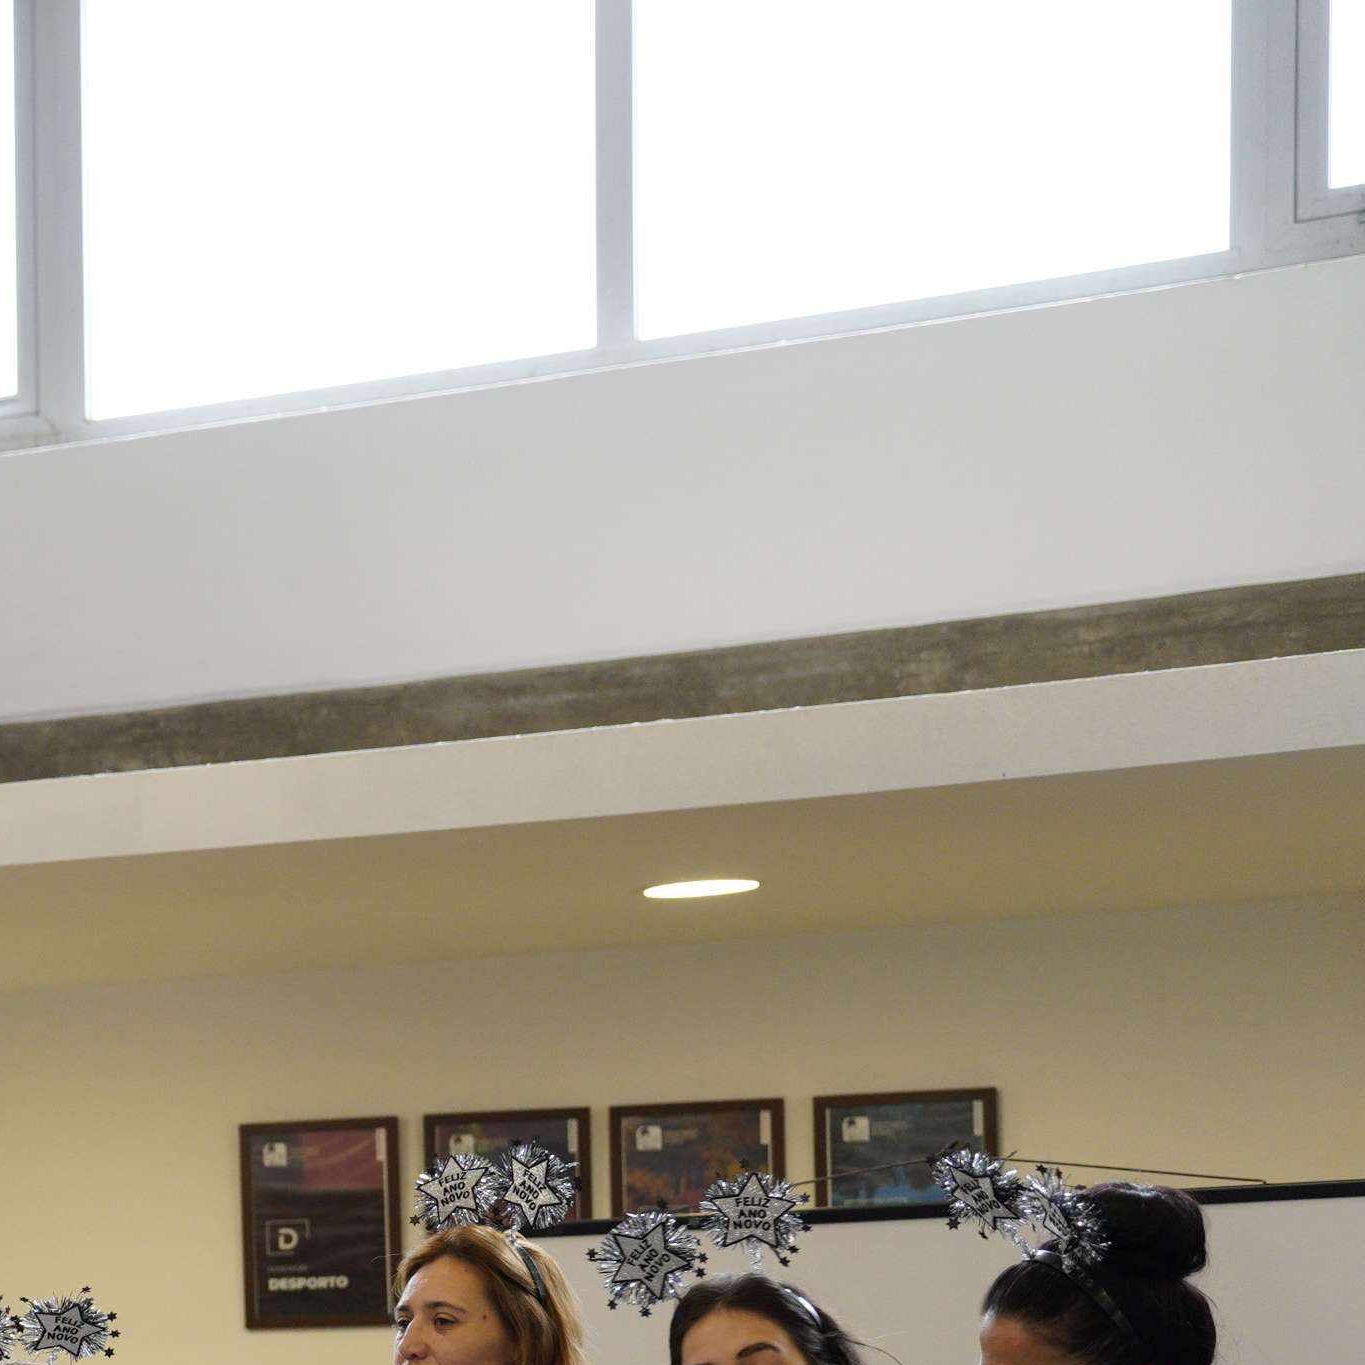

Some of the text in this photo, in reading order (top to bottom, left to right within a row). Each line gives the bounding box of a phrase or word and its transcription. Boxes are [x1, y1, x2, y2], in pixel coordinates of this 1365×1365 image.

[439, 1172, 467, 1187] FELIZ
[523, 1169, 547, 1192] FELIZ
[443, 1182, 465, 1195] ANO
[519, 1180, 539, 1200] ANO
[441, 1192, 470, 1207] NOVO
[513, 1185, 537, 1210] NOVO
[735, 1197, 770, 1208] FELIZ
[971, 1190, 989, 1204] ANO
[738, 1209, 767, 1219] ANO
[977, 1200, 1000, 1214] NOVO
[733, 1220, 771, 1231] NOVO
[627, 1238, 651, 1267] FELIZ
[639, 1251, 659, 1272] ANO
[644, 1254, 671, 1282] NOVO
[267, 1276, 349, 1292] DESPORTO
[55, 1316, 85, 1328] FELIZ
[53, 1326, 79, 1335] ANO
[47, 1332, 79, 1344] NOVO
